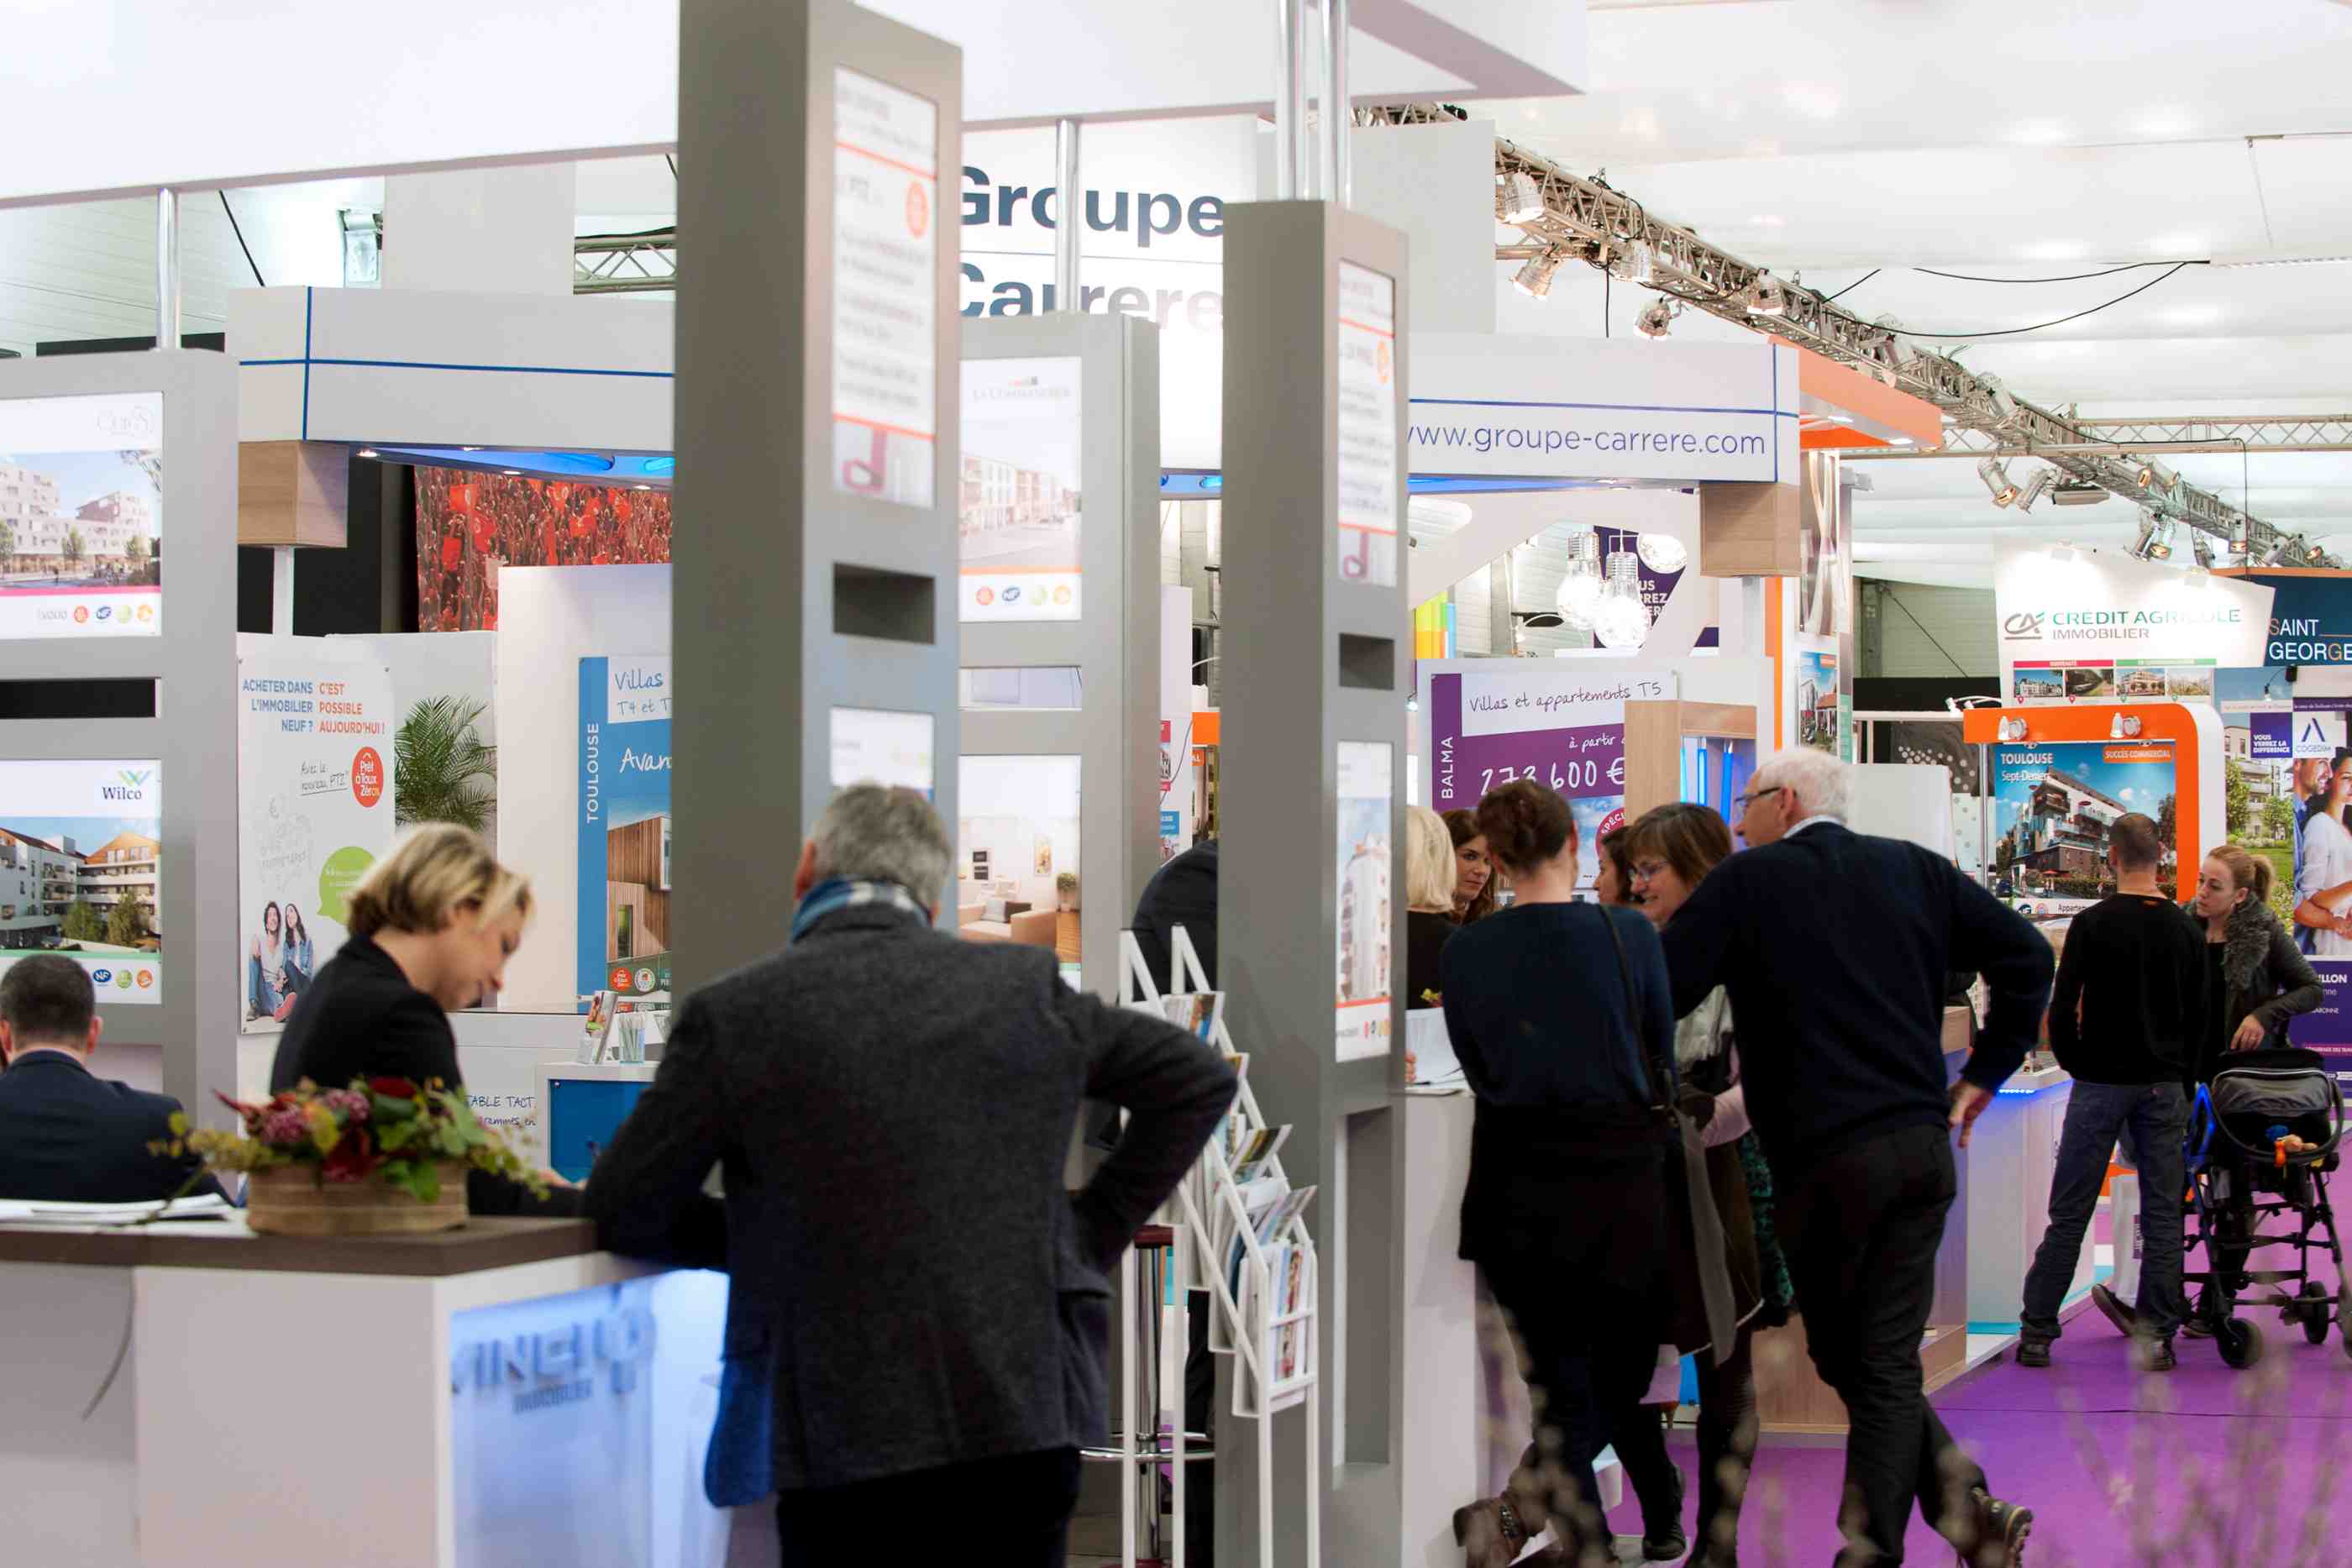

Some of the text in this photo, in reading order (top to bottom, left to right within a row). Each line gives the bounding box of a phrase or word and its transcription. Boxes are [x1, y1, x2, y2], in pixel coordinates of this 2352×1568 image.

[962, 165, 1224, 248] Groupe
[1407, 425, 1766, 454] ww.groupe-carrere.com
[2052, 627, 2150, 640] IMMOBILIER
[2270, 618, 2319, 636] SAINT
[243, 679, 313, 694] ACHETER DANS
[615, 669, 664, 690] Villas
[319, 683, 344, 695] C'EST
[1470, 681, 1662, 712] Villas et appartements T5
[251, 698, 313, 713] L'IMMOBILIER
[319, 701, 363, 716] POSSIBLE
[617, 700, 636, 716] T4
[642, 701, 656, 713] et
[281, 718, 307, 732] NEUF
[319, 719, 381, 735] AUJOURD'HUI
[1568, 732, 1615, 753] à partir
[2000, 753, 2054, 765] TOULOUSE
[586, 722, 599, 824] TOULOUSE
[1441, 736, 1454, 800] BALMA
[102, 786, 142, 800] Wilco
